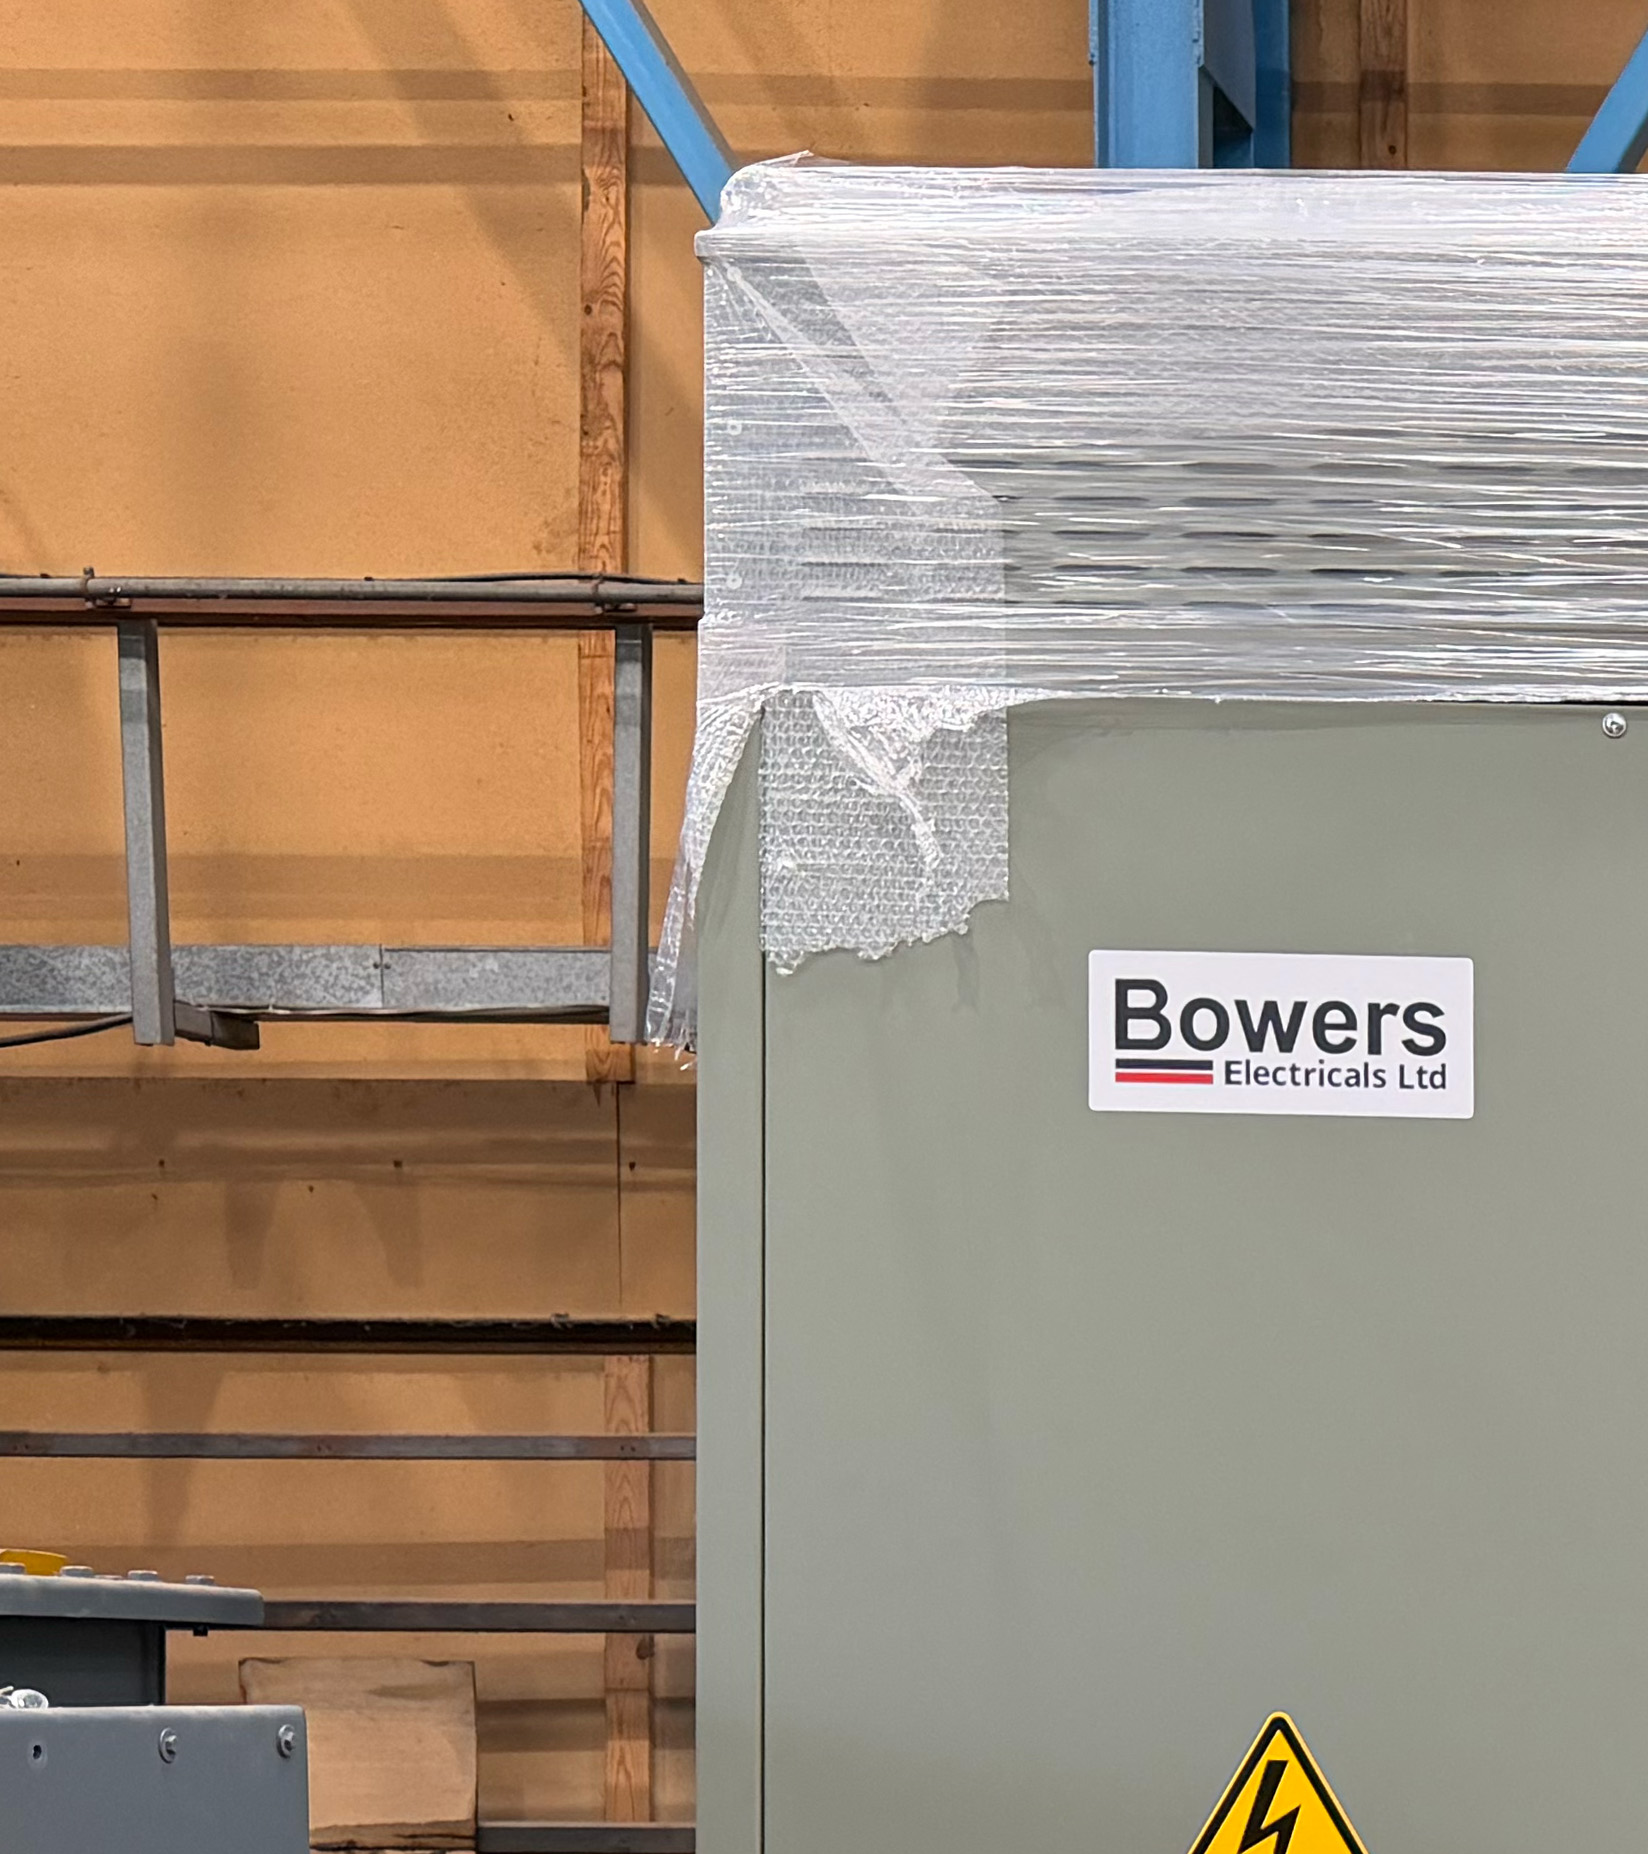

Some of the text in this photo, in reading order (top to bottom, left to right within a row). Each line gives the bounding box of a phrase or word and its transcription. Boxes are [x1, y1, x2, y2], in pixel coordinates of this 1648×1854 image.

[1115, 978, 1447, 1057] Bowers
[1224, 1059, 1446, 1090] Electricals Ltd
